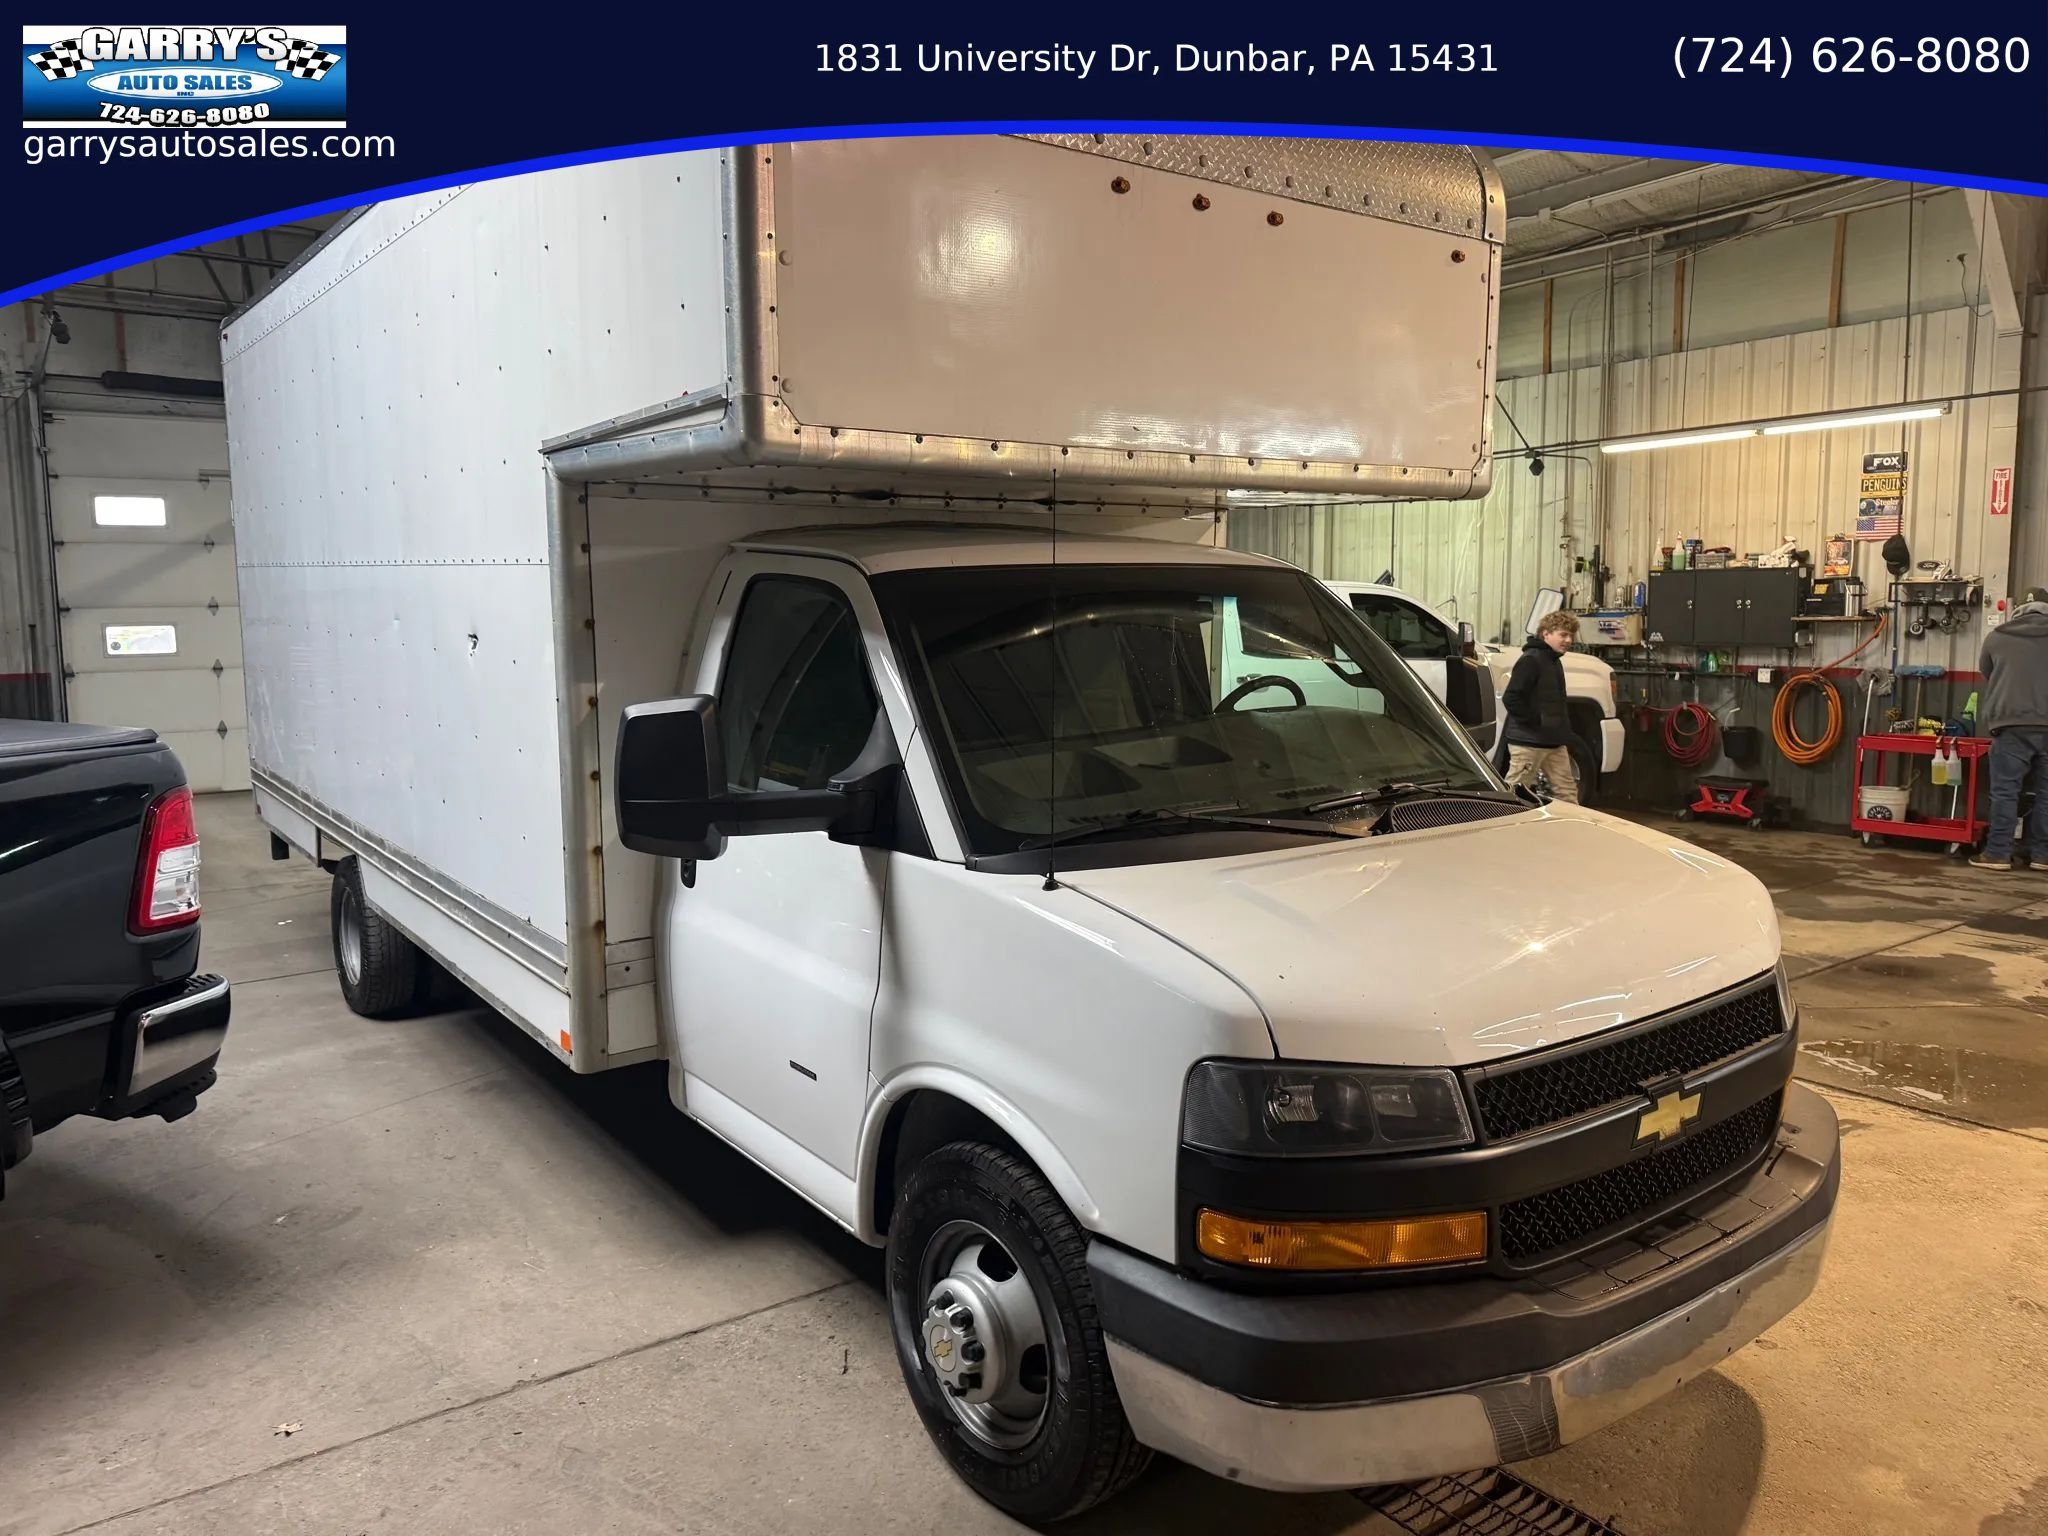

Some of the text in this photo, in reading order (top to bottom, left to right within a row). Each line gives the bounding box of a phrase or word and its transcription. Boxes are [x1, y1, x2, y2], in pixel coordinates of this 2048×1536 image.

[1873, 456, 1899, 467] FOX
[1995, 472, 2008, 480] FIRE
[1863, 477, 1907, 491] PENGUINS
